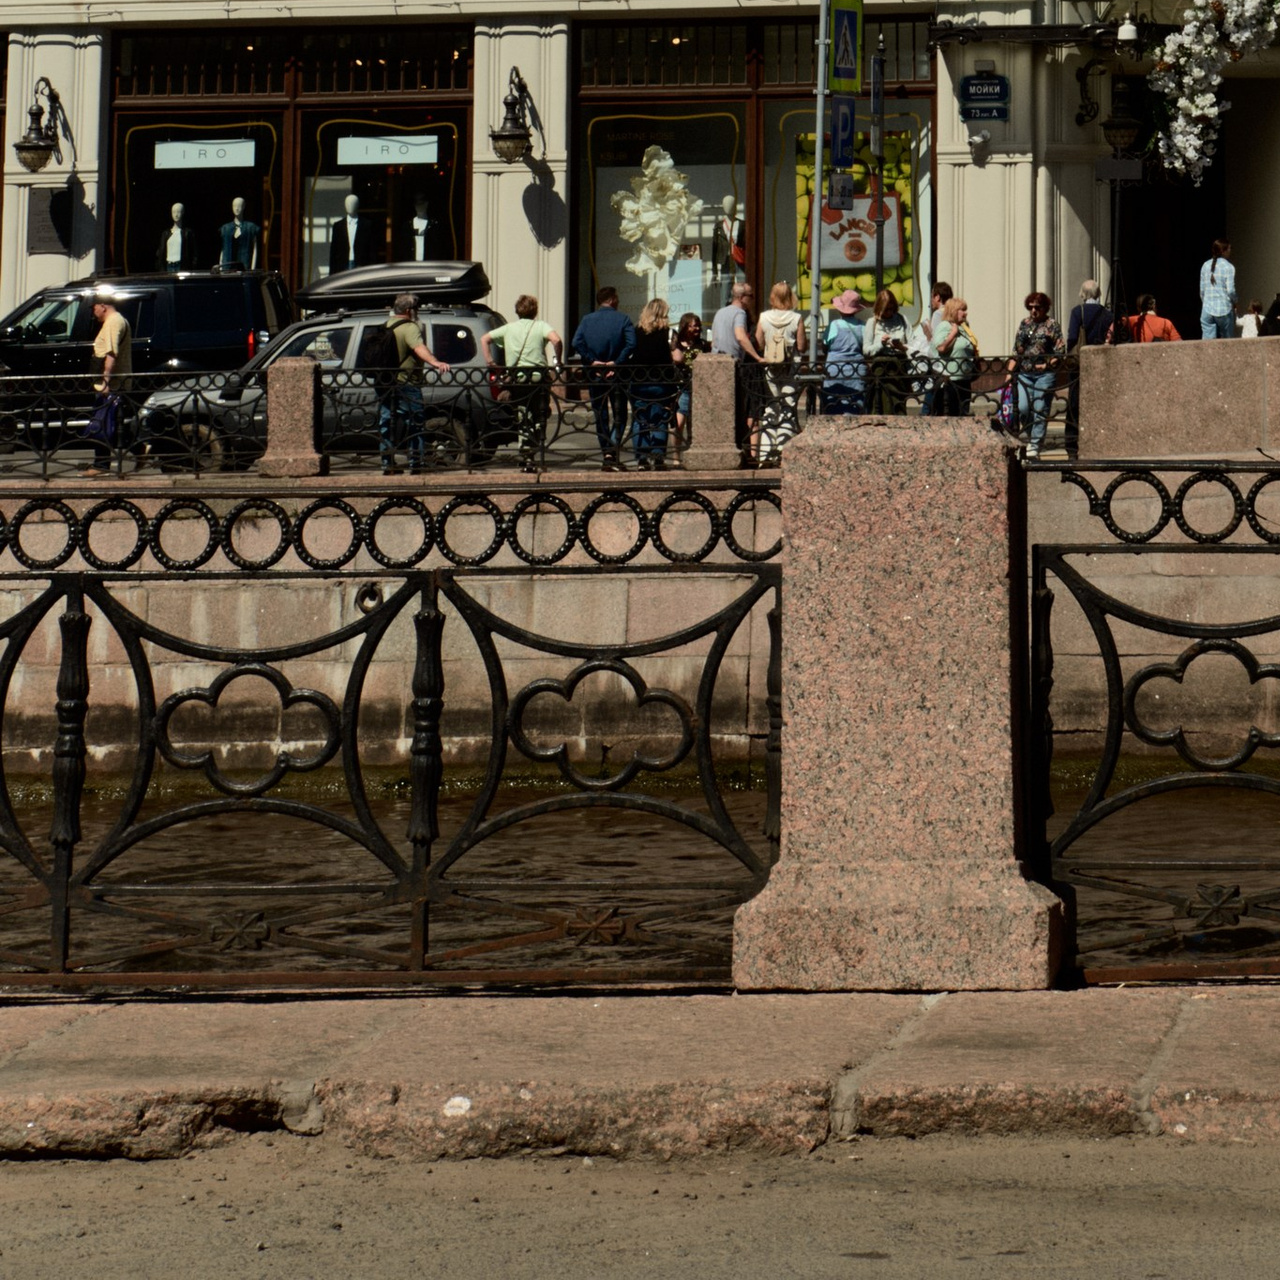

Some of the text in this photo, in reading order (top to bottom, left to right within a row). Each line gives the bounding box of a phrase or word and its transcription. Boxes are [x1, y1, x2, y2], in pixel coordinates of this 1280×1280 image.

[969, 83, 1000, 94] МОЙКИ
[970, 109, 980, 117] 73
[183, 148, 227, 160] IRO
[365, 144, 410, 155] IRO
[829, 218, 877, 241] LANCE
